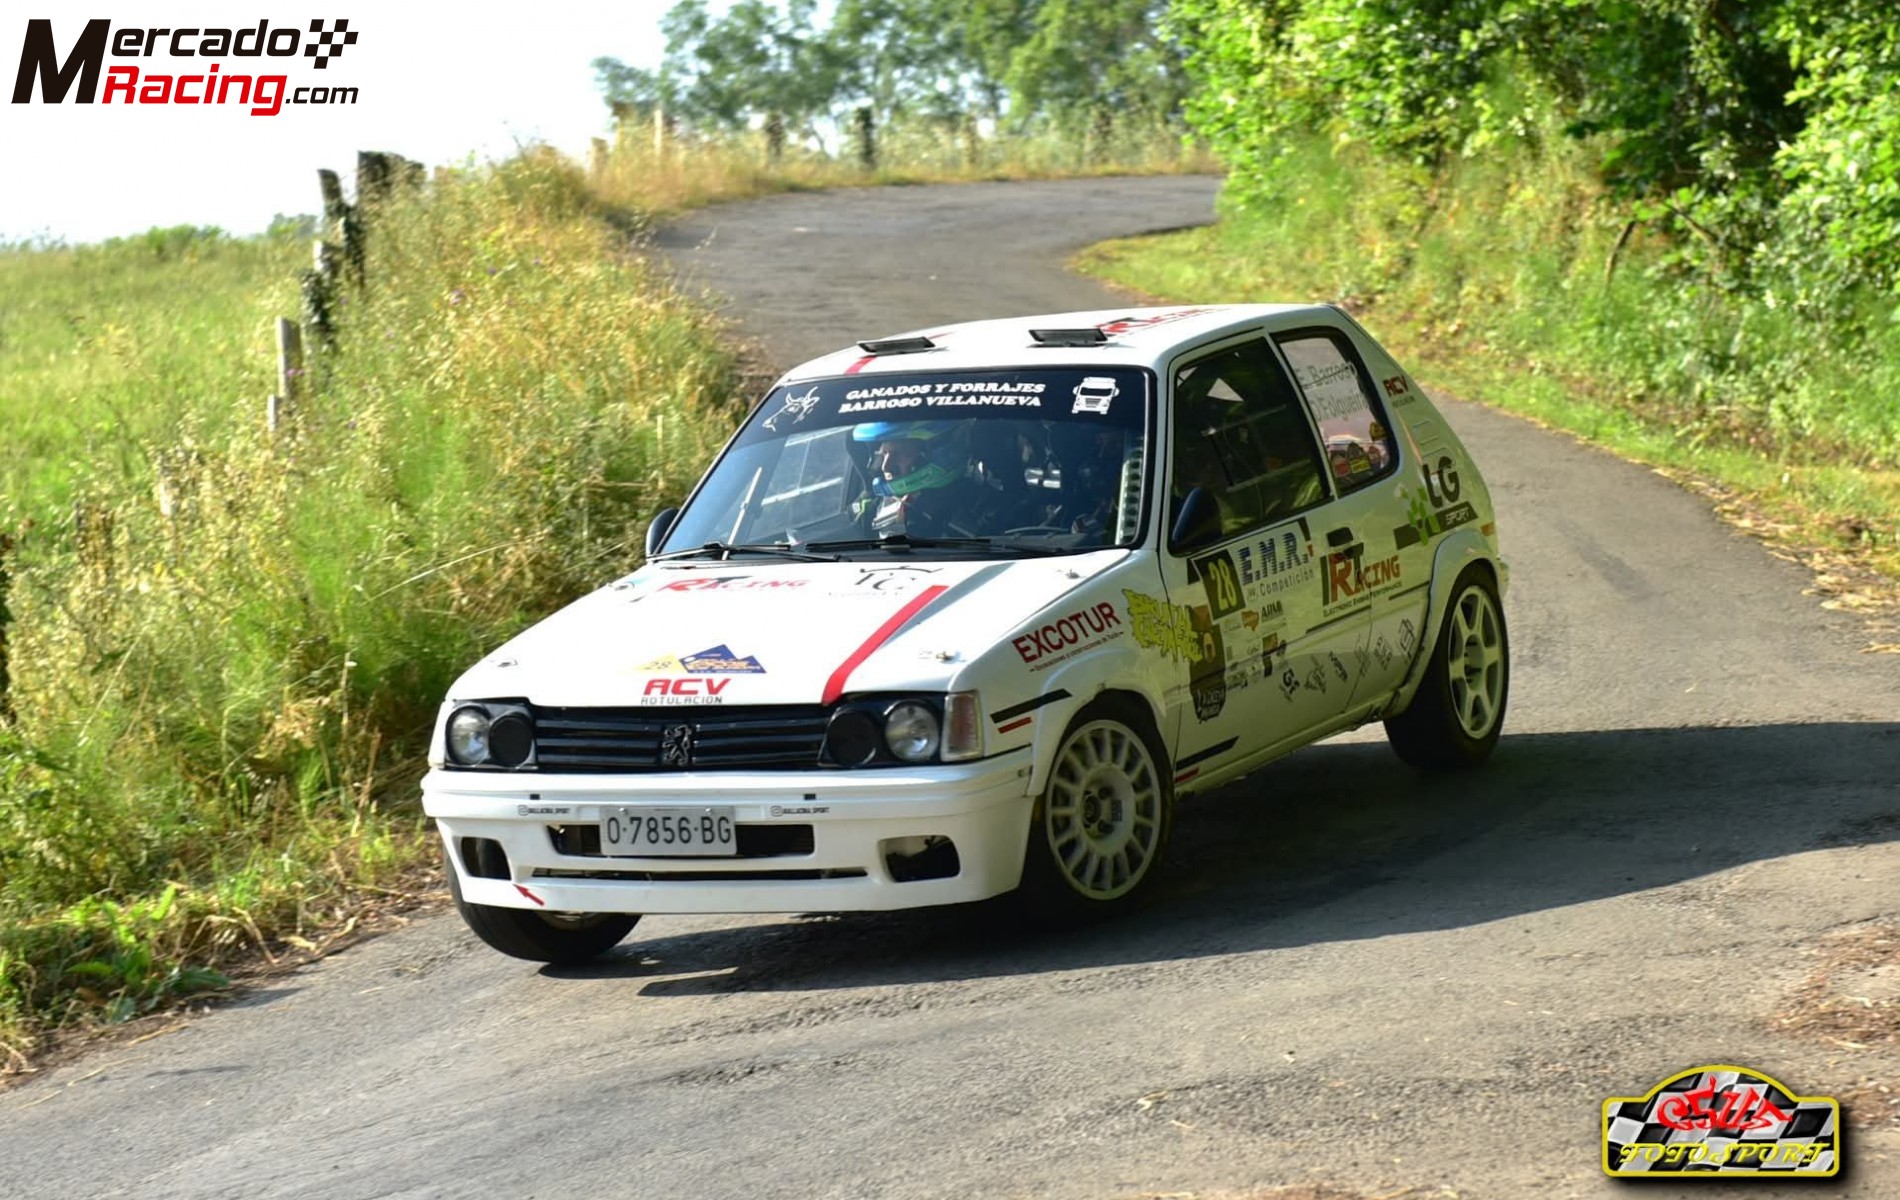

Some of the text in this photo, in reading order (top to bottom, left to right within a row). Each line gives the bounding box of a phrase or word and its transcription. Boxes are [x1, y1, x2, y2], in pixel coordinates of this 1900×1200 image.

[846, 383, 1046, 400] GANADOS Y FORRAJES
[839, 395, 1041, 413] BARROSO VILLANUEVA
[1445, 507, 1470, 526] SPORT
[1207, 557, 1238, 610] 28
[1011, 602, 1122, 664] EXCOTUR
[643, 678, 731, 696] ACV
